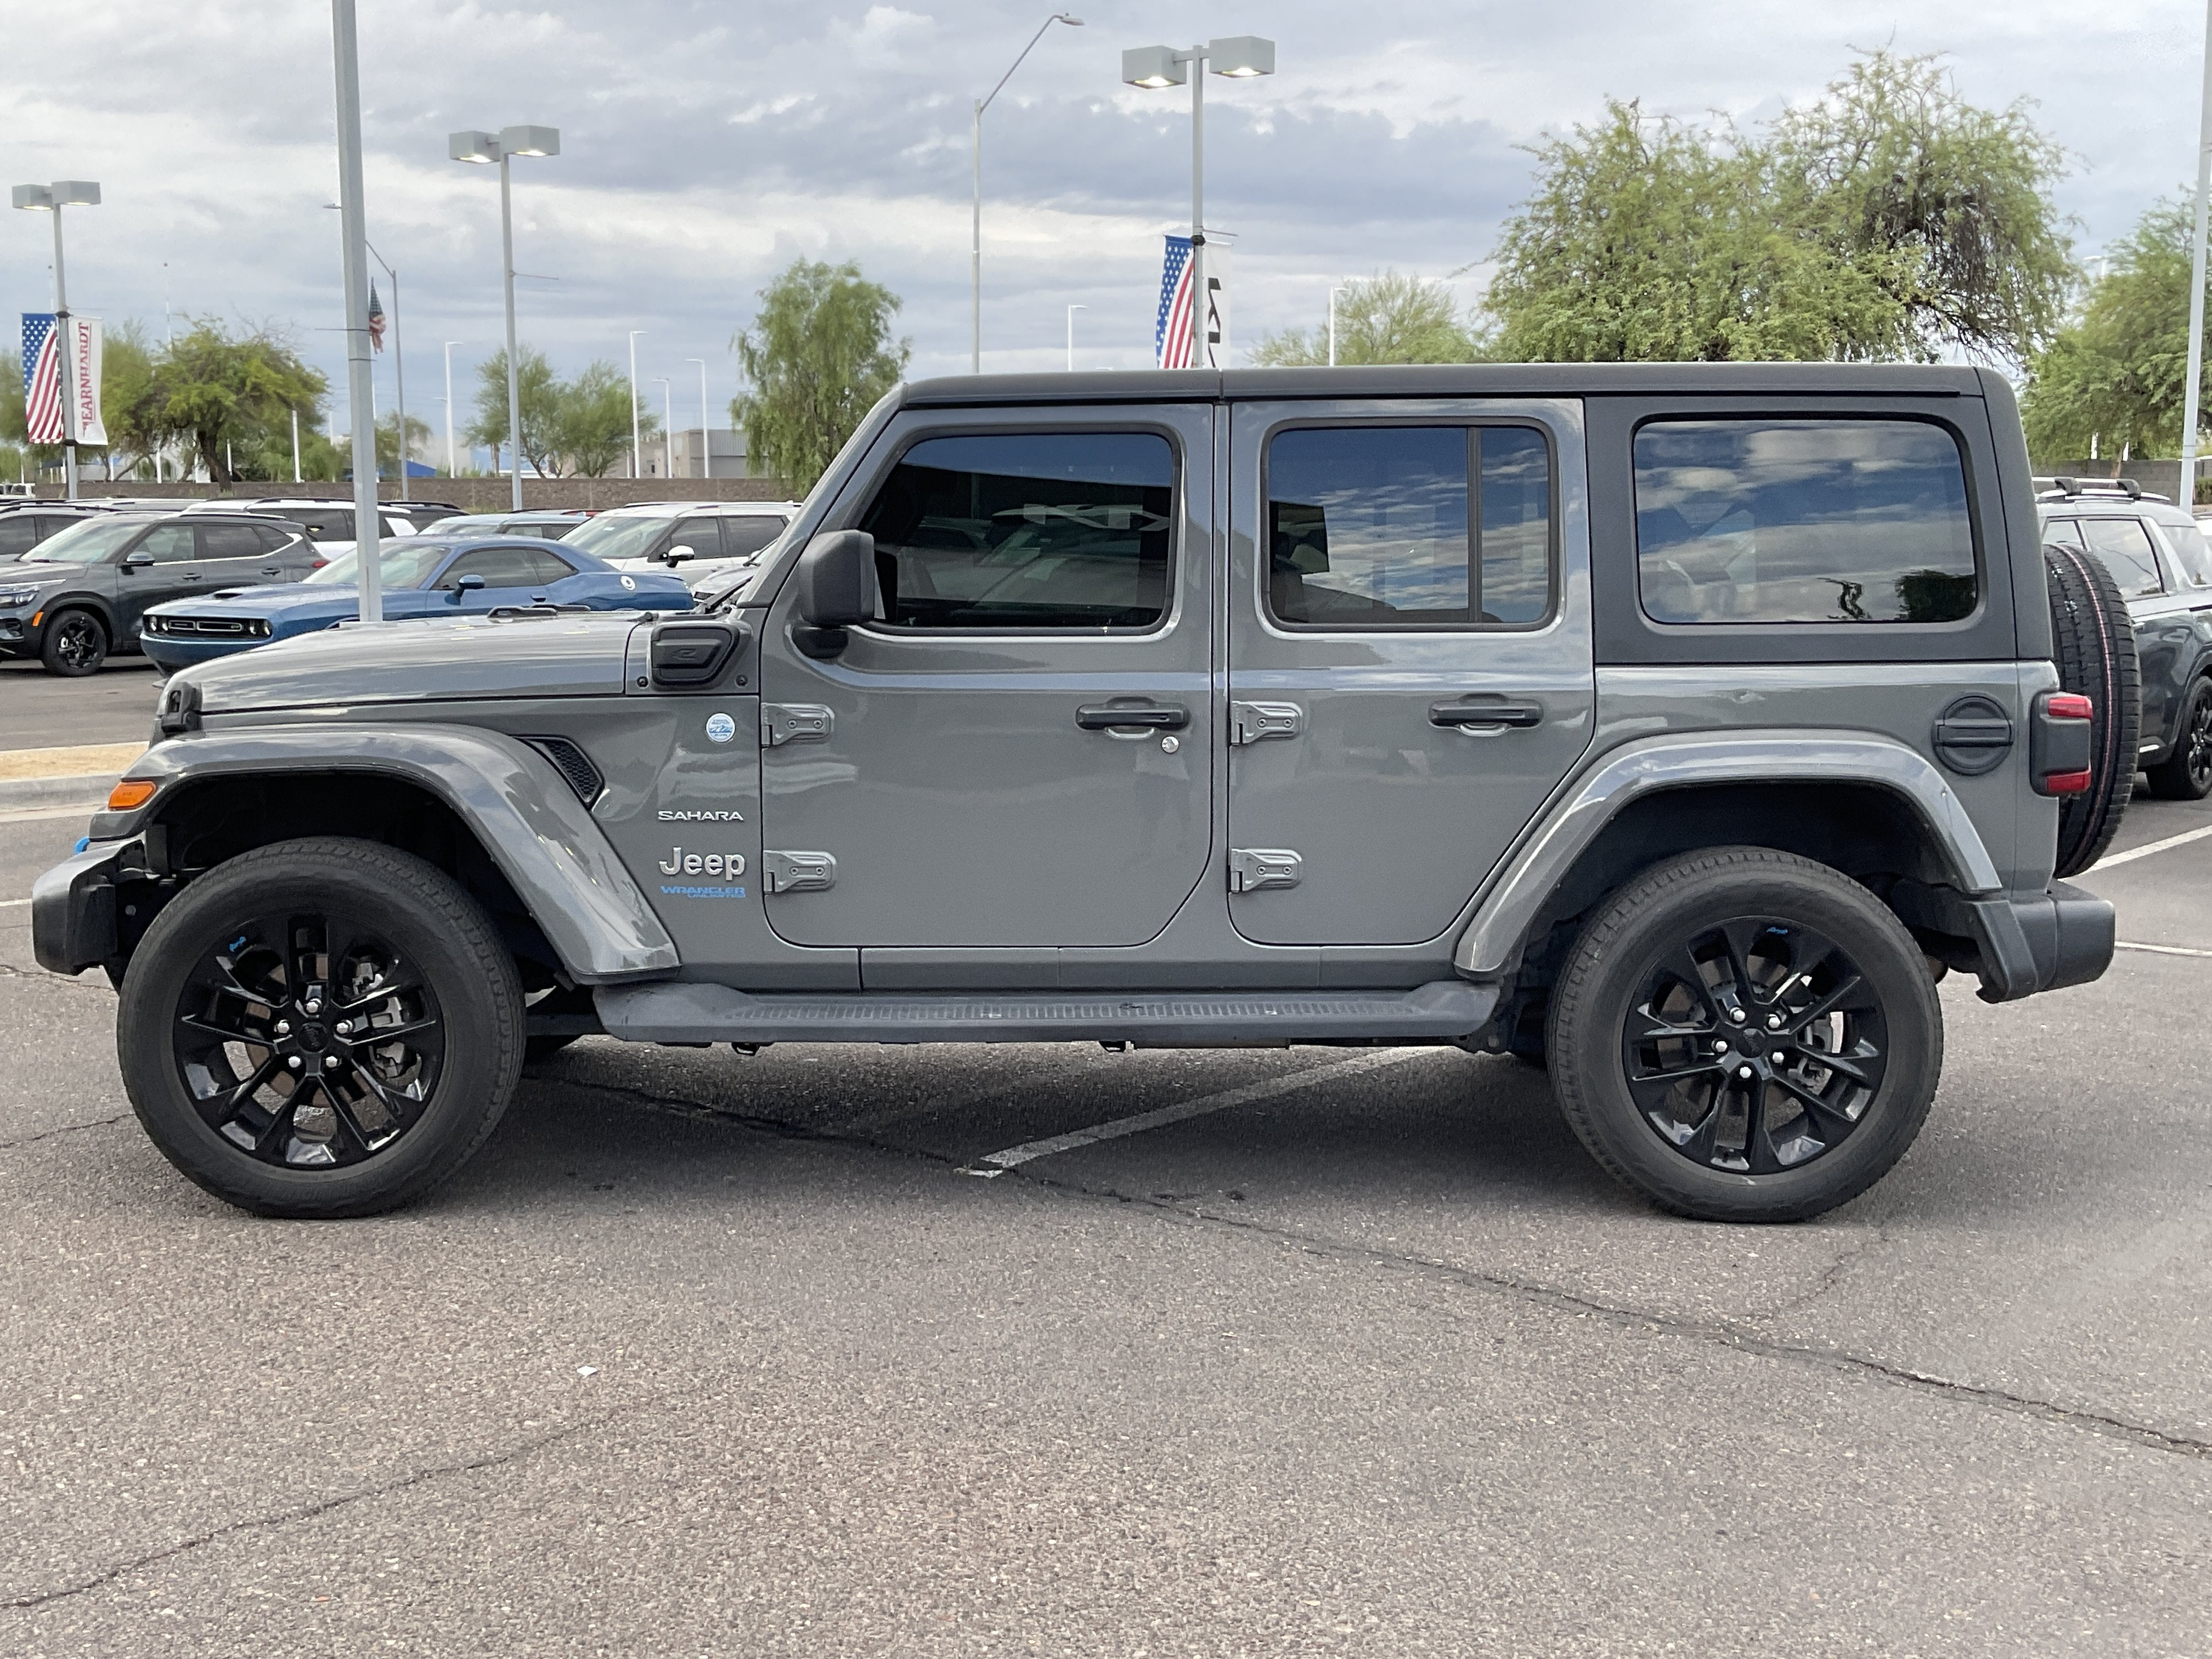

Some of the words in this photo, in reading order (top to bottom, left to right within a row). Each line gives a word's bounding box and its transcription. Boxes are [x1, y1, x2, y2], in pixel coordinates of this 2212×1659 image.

[78, 322, 93, 421] EARNHARDT
[658, 811, 744, 821] SAHARA
[659, 847, 745, 881] Jeep
[661, 885, 745, 894] WRANGLER
